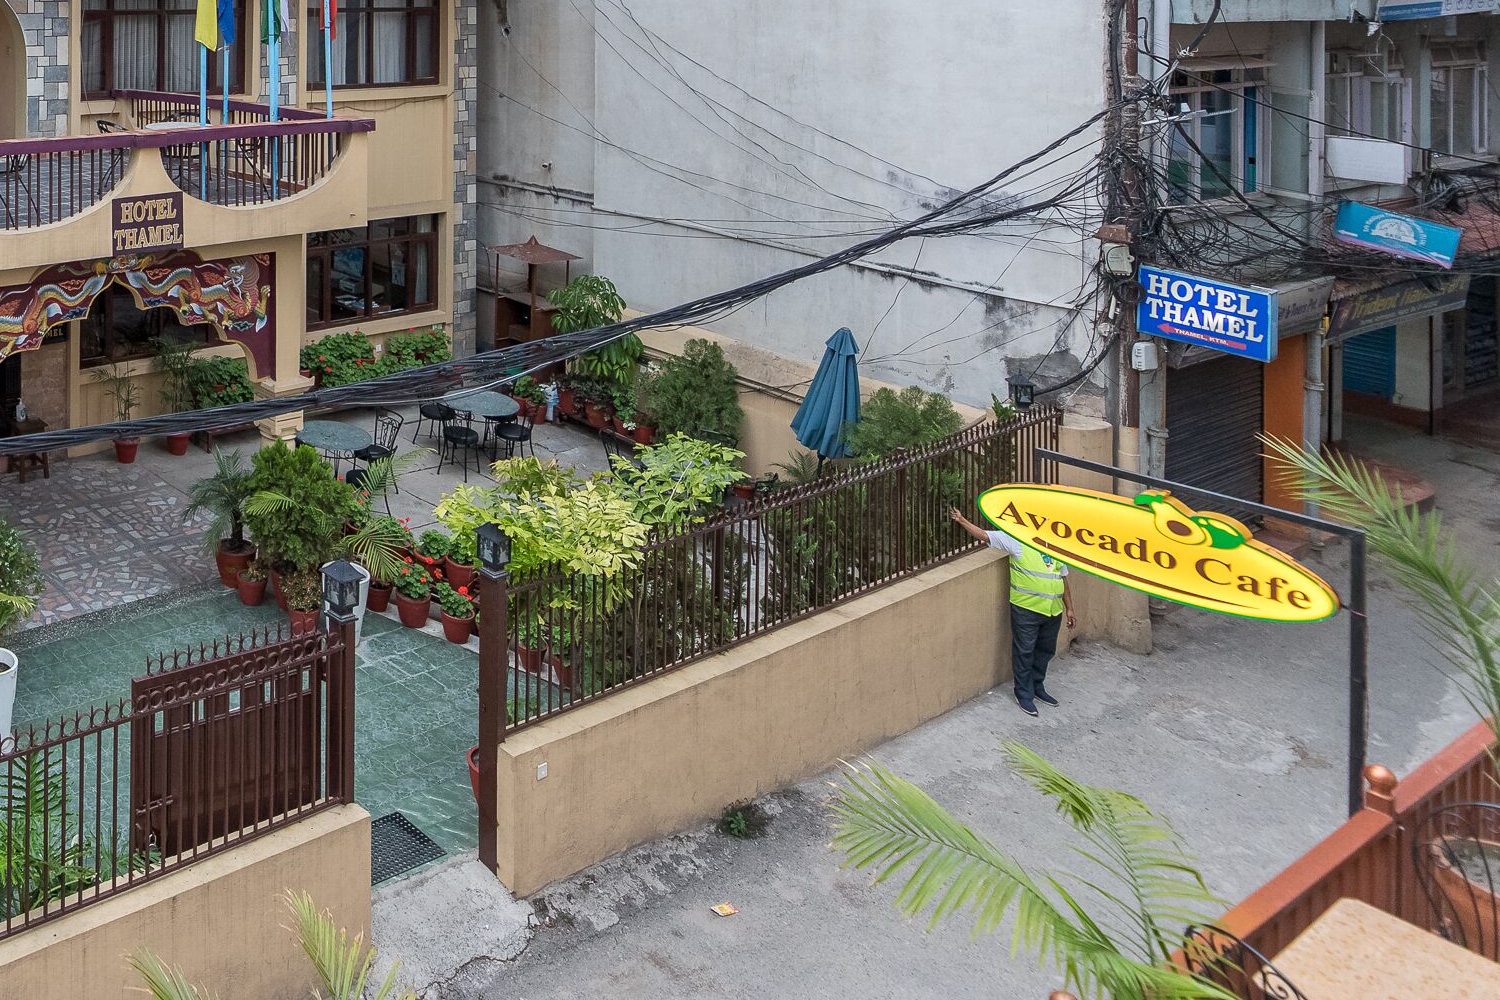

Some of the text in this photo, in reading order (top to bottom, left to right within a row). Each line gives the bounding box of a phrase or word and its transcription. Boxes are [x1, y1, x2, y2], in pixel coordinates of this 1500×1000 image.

[121, 198, 177, 224] HOTEL
[114, 223, 183, 251] THAMEL
[1147, 273, 1259, 317] HOTEL
[1145, 296, 1264, 343] THAMEL
[995, 501, 1314, 610] Avocado Cafe
